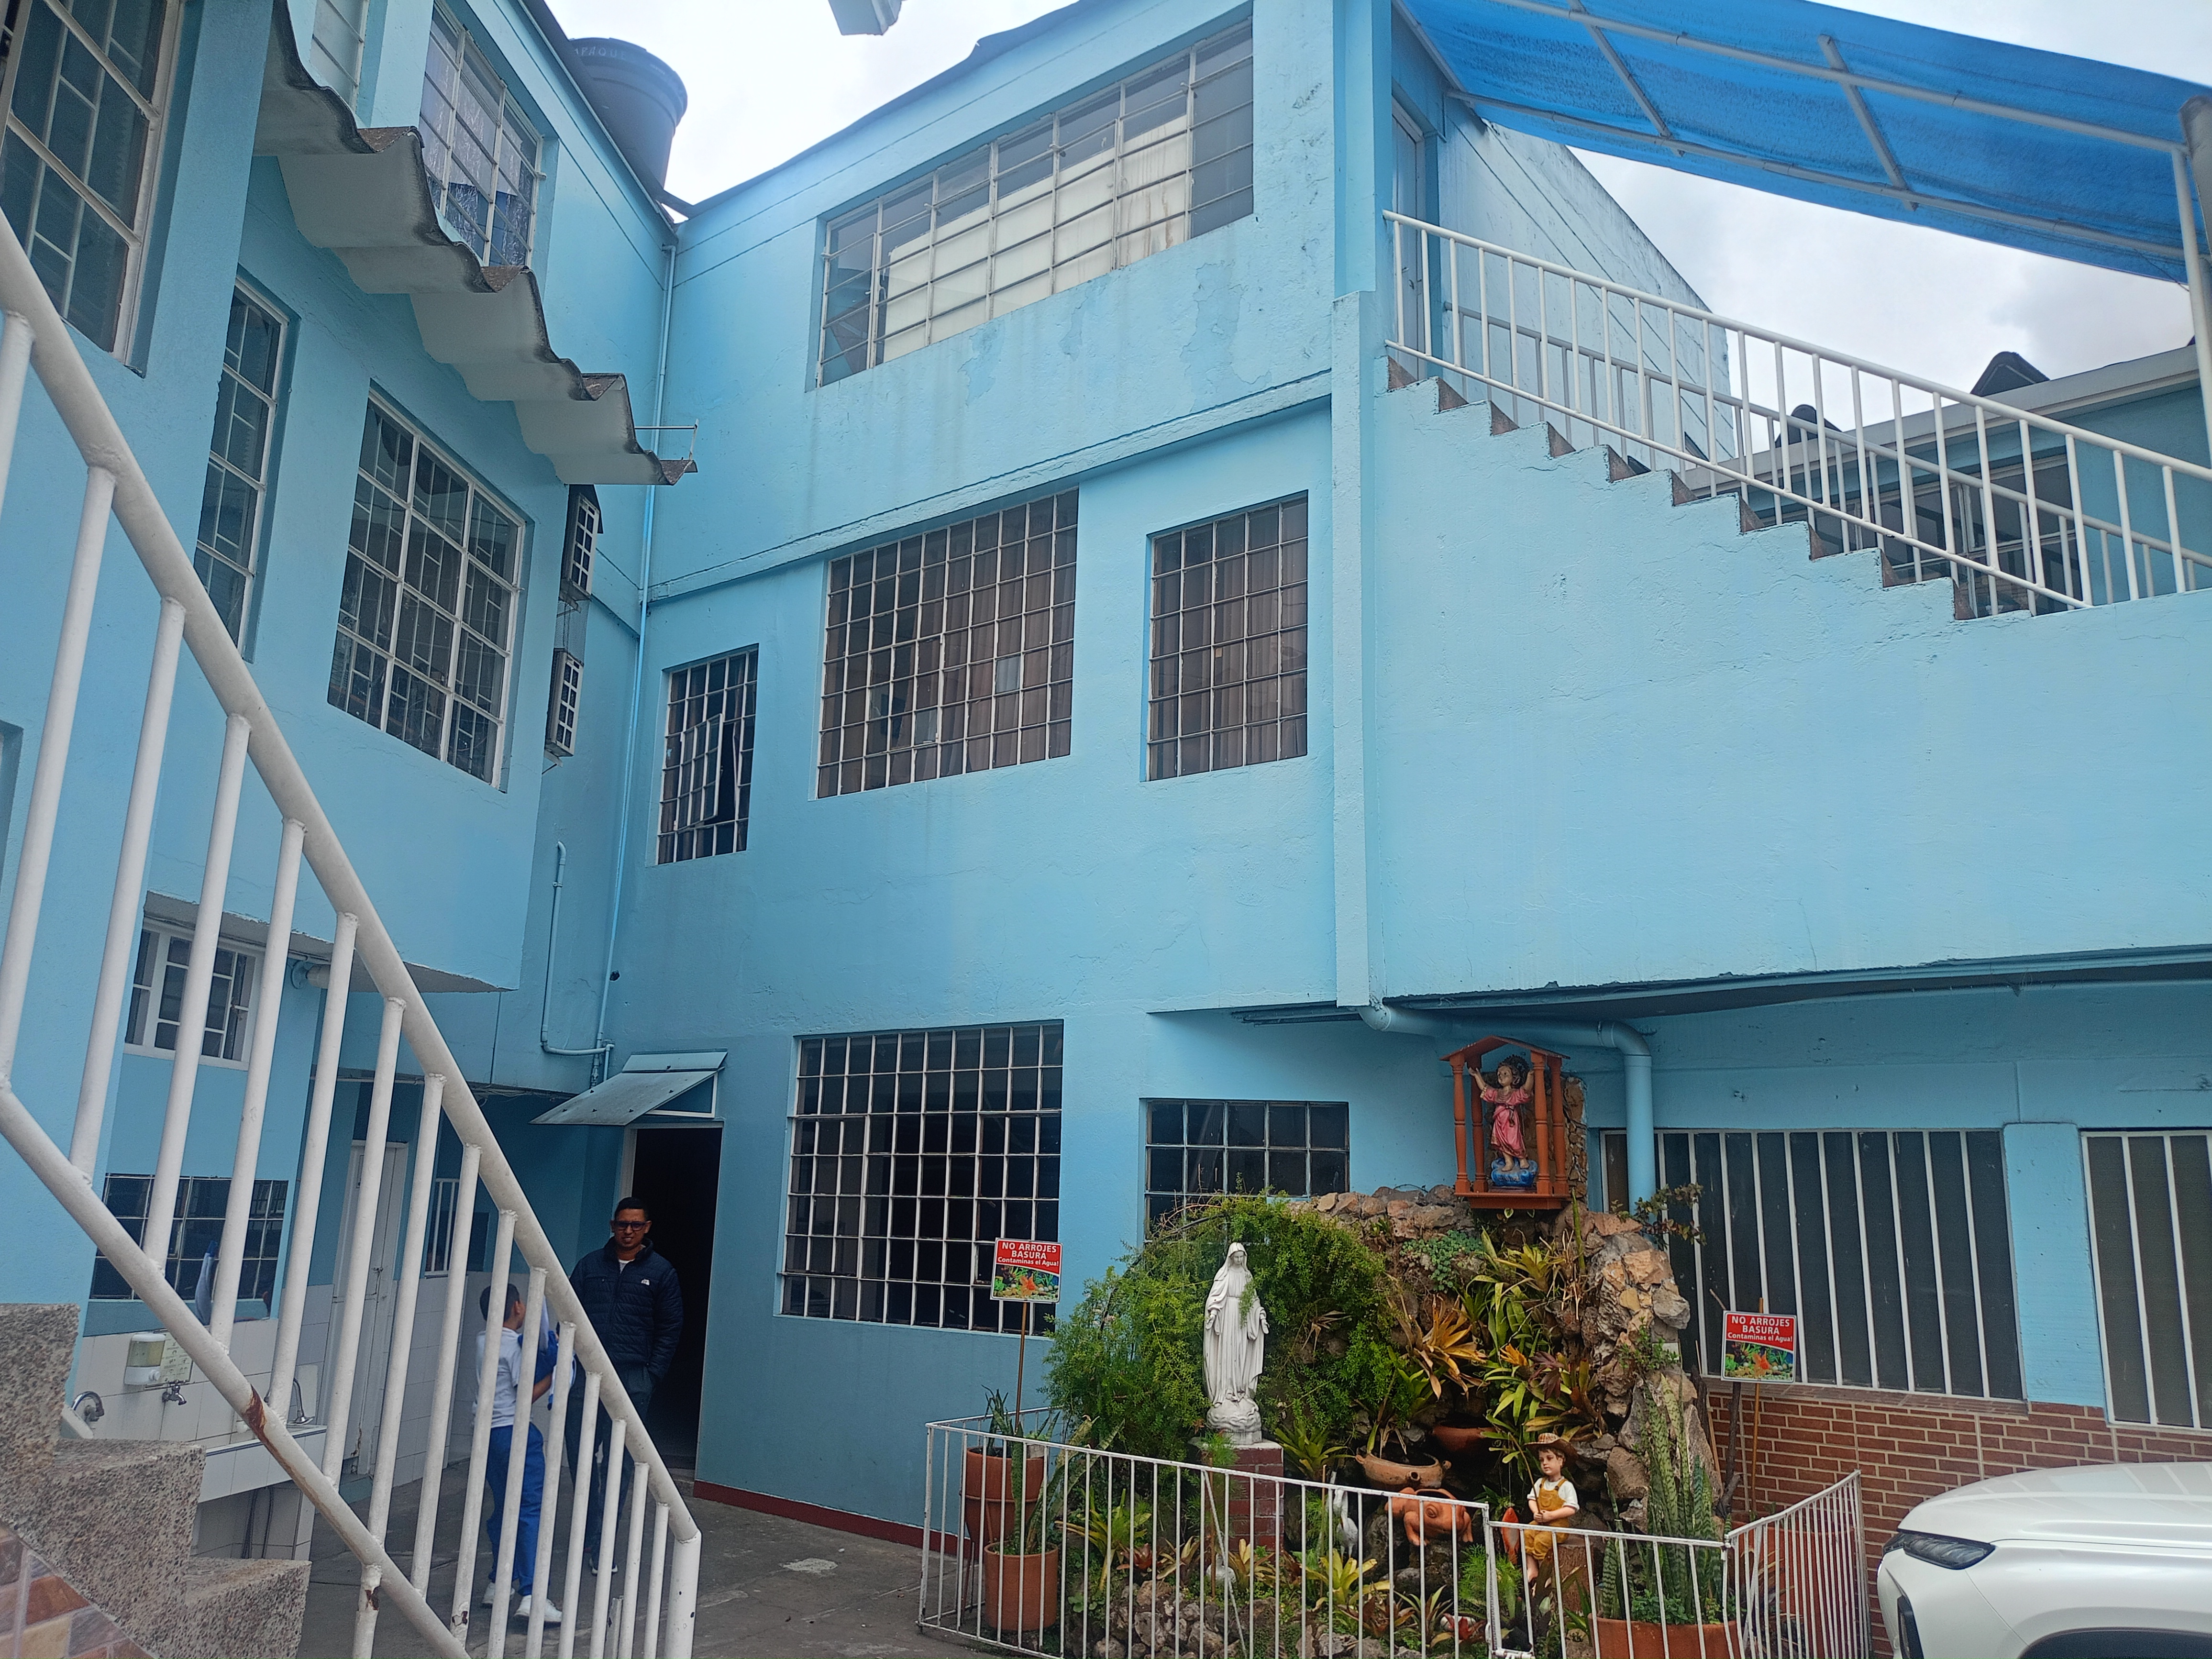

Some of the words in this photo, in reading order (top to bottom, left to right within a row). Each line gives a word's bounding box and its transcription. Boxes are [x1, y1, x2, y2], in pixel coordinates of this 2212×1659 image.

[1018, 1243, 1057, 1253] ARROJES
[1011, 1250, 1047, 1260] BASURA
[1731, 1316, 1746, 1324] NO
[1749, 1317, 1790, 1327] ARROJES
[1742, 1325, 1780, 1335] BASURA
[1727, 1332, 1767, 1340] Contaminas
